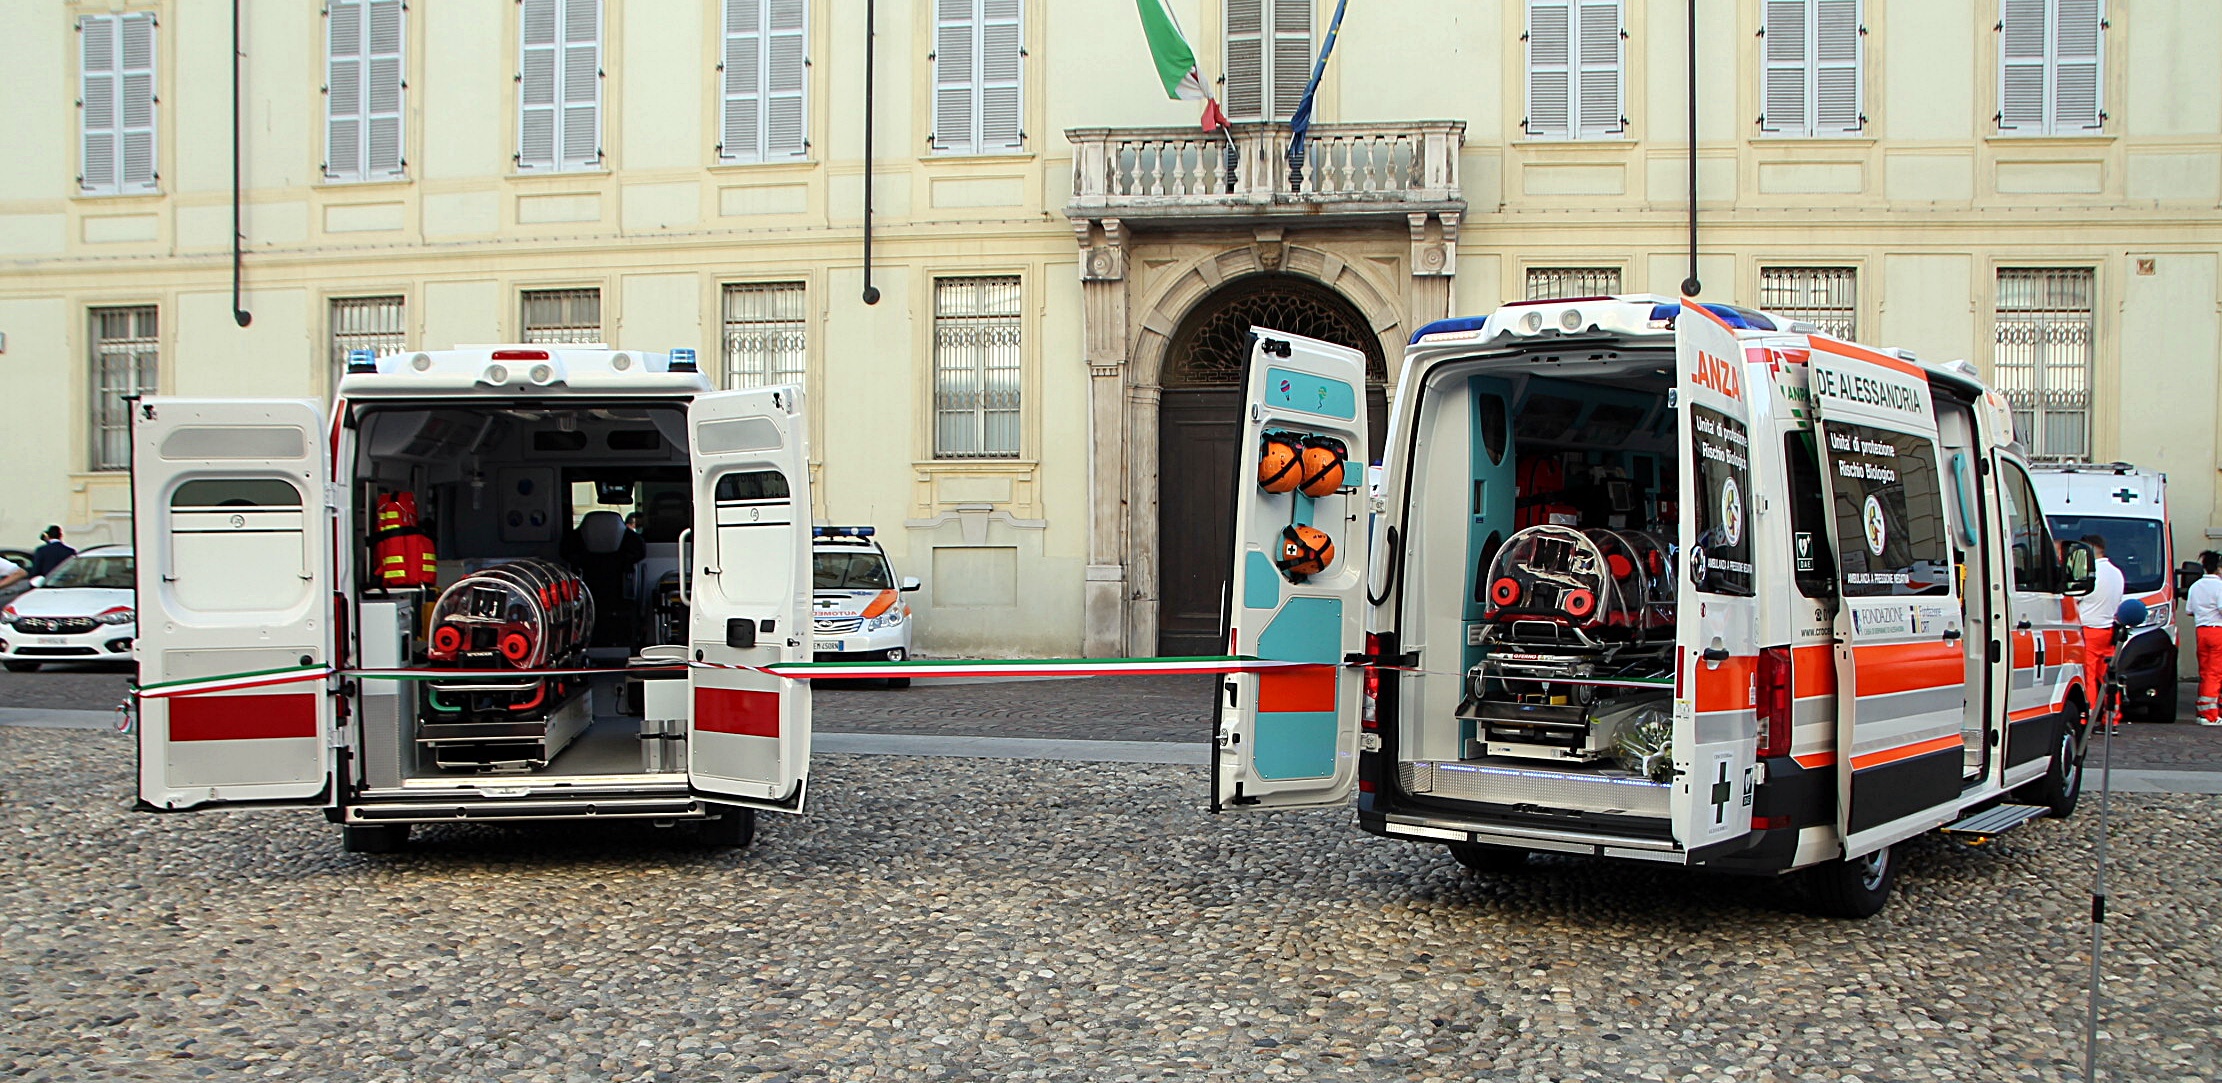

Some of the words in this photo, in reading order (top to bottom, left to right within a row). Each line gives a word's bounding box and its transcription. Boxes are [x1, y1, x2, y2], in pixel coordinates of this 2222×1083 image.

[1816, 368, 1836, 397] DE
[1840, 373, 1922, 414] ALESSANDRIA
[1696, 415, 1715, 435] Unita'
[1716, 421, 1723, 438] di
[1702, 441, 1725, 462] Rischio
[1830, 432, 1850, 451] Unita'
[1853, 436, 1860, 452] di
[1861, 440, 1895, 457] protezione
[1838, 459, 1864, 478] Rischio
[1865, 463, 1895, 484] Biologico
[1800, 560, 1811, 569] DAE
[1847, 573, 1869, 584] AMBULANZA
[1874, 573, 1893, 584] PRESSIONE
[1861, 606, 1904, 625] FONDAZIONE
